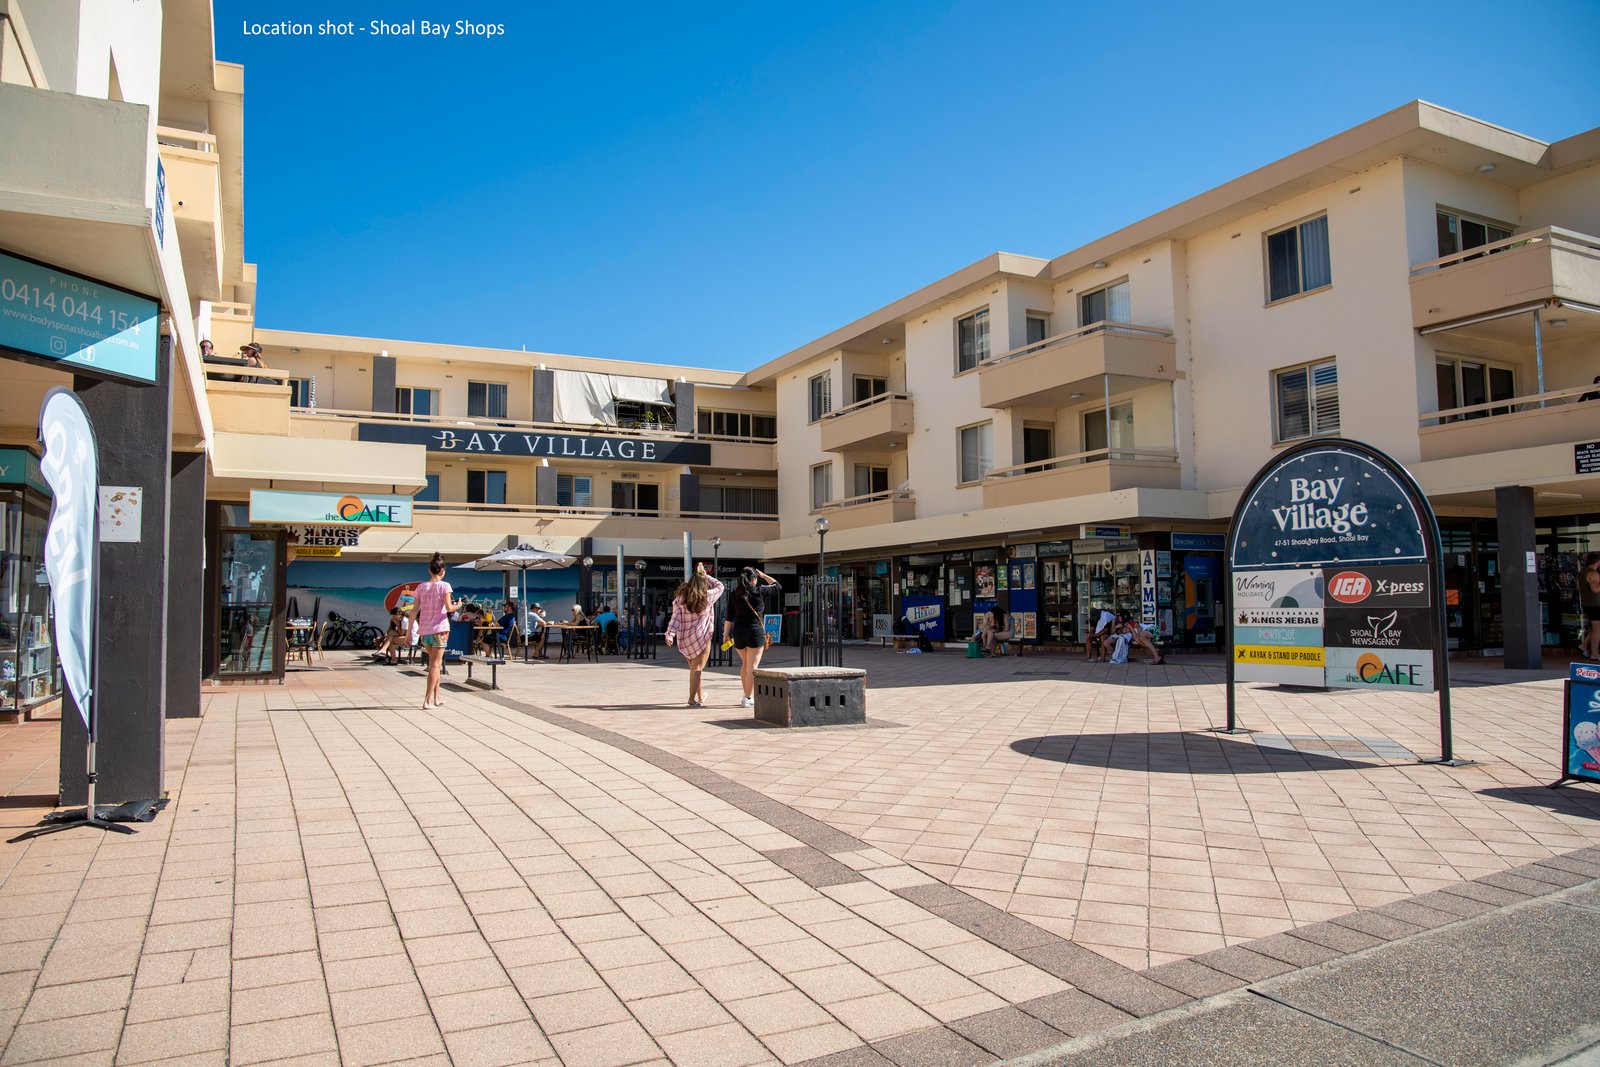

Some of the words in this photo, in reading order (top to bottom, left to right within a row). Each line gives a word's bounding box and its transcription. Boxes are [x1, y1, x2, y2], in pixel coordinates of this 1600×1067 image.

[50, 277, 99, 298] PHONE
[2, 278, 57, 313] 0414
[62, 296, 103, 325] 044
[110, 309, 141, 336] 154
[3, 307, 140, 350] www.bodyspotatshoalbay.com.au
[431, 429, 507, 451] BAY
[523, 434, 657, 460] VILLAGE
[1289, 476, 1345, 505] Bay
[46, 419, 89, 599] OPEN
[325, 512, 339, 521] the
[340, 503, 401, 523] CAFE
[1272, 502, 1369, 534] Village
[303, 528, 359, 538] KINGS
[303, 537, 359, 547] KEBAB
[1320, 536, 1338, 544] Road,
[1357, 534, 1369, 542] Bay
[1143, 550, 1155, 603] ATM
[1333, 577, 1367, 596] IGA
[1375, 579, 1425, 597] X-press
[1235, 575, 1275, 601] Winning
[1251, 616, 1282, 625] KINGS
[1284, 616, 1319, 625] KEBAB
[1350, 629, 1373, 637] SHOAL
[1388, 629, 1402, 637] BAY
[1352, 638, 1400, 646] NEWSAGENCY
[1249, 650, 1267, 659] KAYAK
[1267, 651, 1272, 660] &
[1272, 651, 1291, 660] STAND
[1291, 652, 1299, 660] UP
[1299, 652, 1321, 662] PADDLE
[1345, 673, 1359, 683] the
[1360, 662, 1424, 687] CAFE
